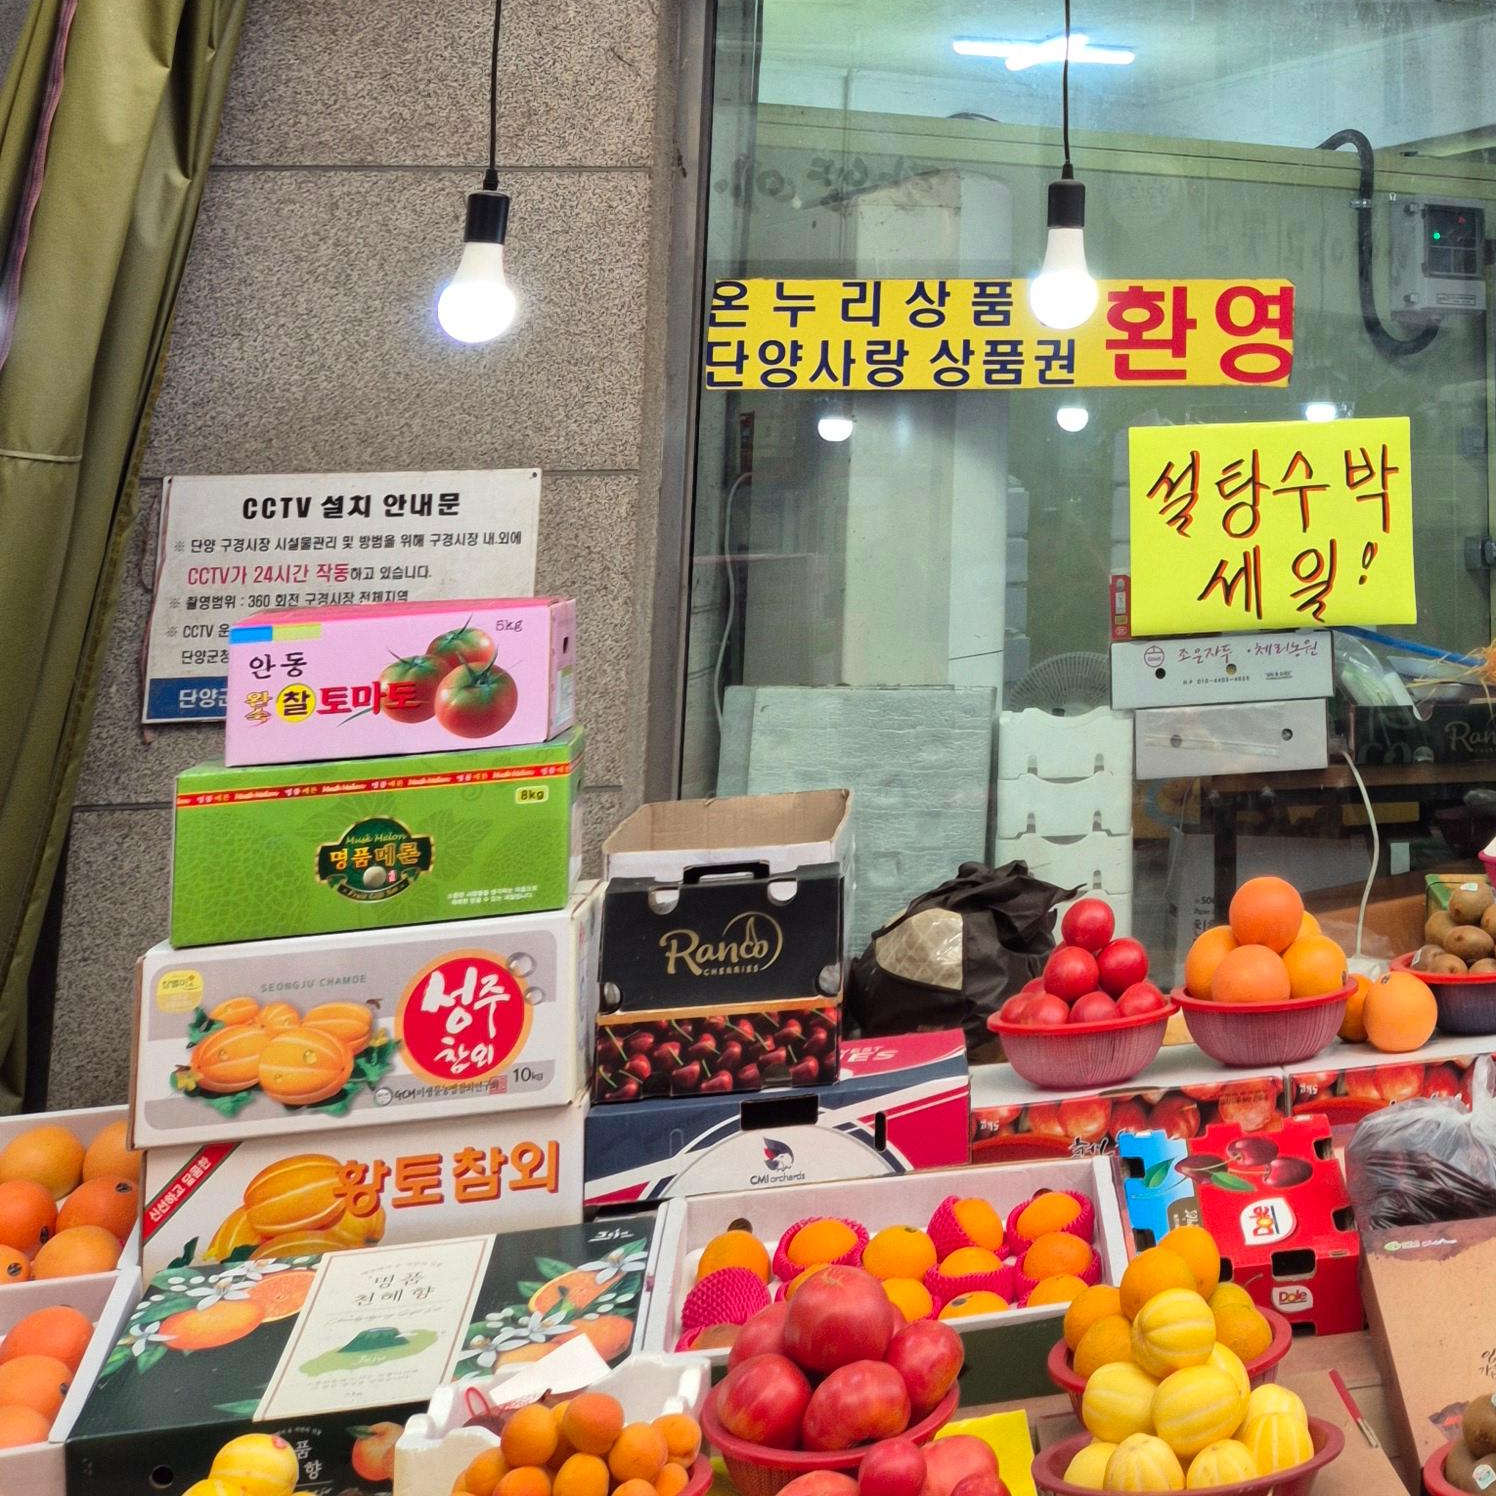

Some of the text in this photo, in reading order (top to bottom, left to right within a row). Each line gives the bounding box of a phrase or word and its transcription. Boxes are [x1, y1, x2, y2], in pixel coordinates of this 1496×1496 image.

[710, 280, 1294, 385] 온누리상품 환영
[706, 339, 1077, 388] 단양사랑 상품권
[242, 491, 461, 519] CCTV 설치 안내문
[190, 538, 216, 554] 단양
[220, 535, 270, 552] 구경시장
[275, 533, 337, 551] 시설물관리
[359, 532, 395, 549] 방범을
[400, 531, 424, 548] 위해
[429, 529, 479, 546] 구경시장
[187, 562, 432, 585] CCTV가 24시간 작동하고 있습니다.
[1197, 538, 1379, 622] 세일!
[248, 595, 271, 608] 360
[183, 625, 213, 638] CCTV
[249, 652, 307, 679] 안동
[284, 679, 422, 717] 찰 토마토
[520, 789, 545, 801] 8kg
[330, 842, 421, 870] 명품메론
[659, 916, 770, 976] Ranco
[260, 974, 367, 993] SEONGJU CHAMOE
[421, 966, 512, 1038] 성주
[512, 1067, 544, 1083] 10kg
[335, 1140, 559, 1218] 황토참외
[749, 1170, 806, 1185] CMI orchards
[1249, 1205, 1275, 1237] Dole
[1279, 1289, 1307, 1304] Dole
